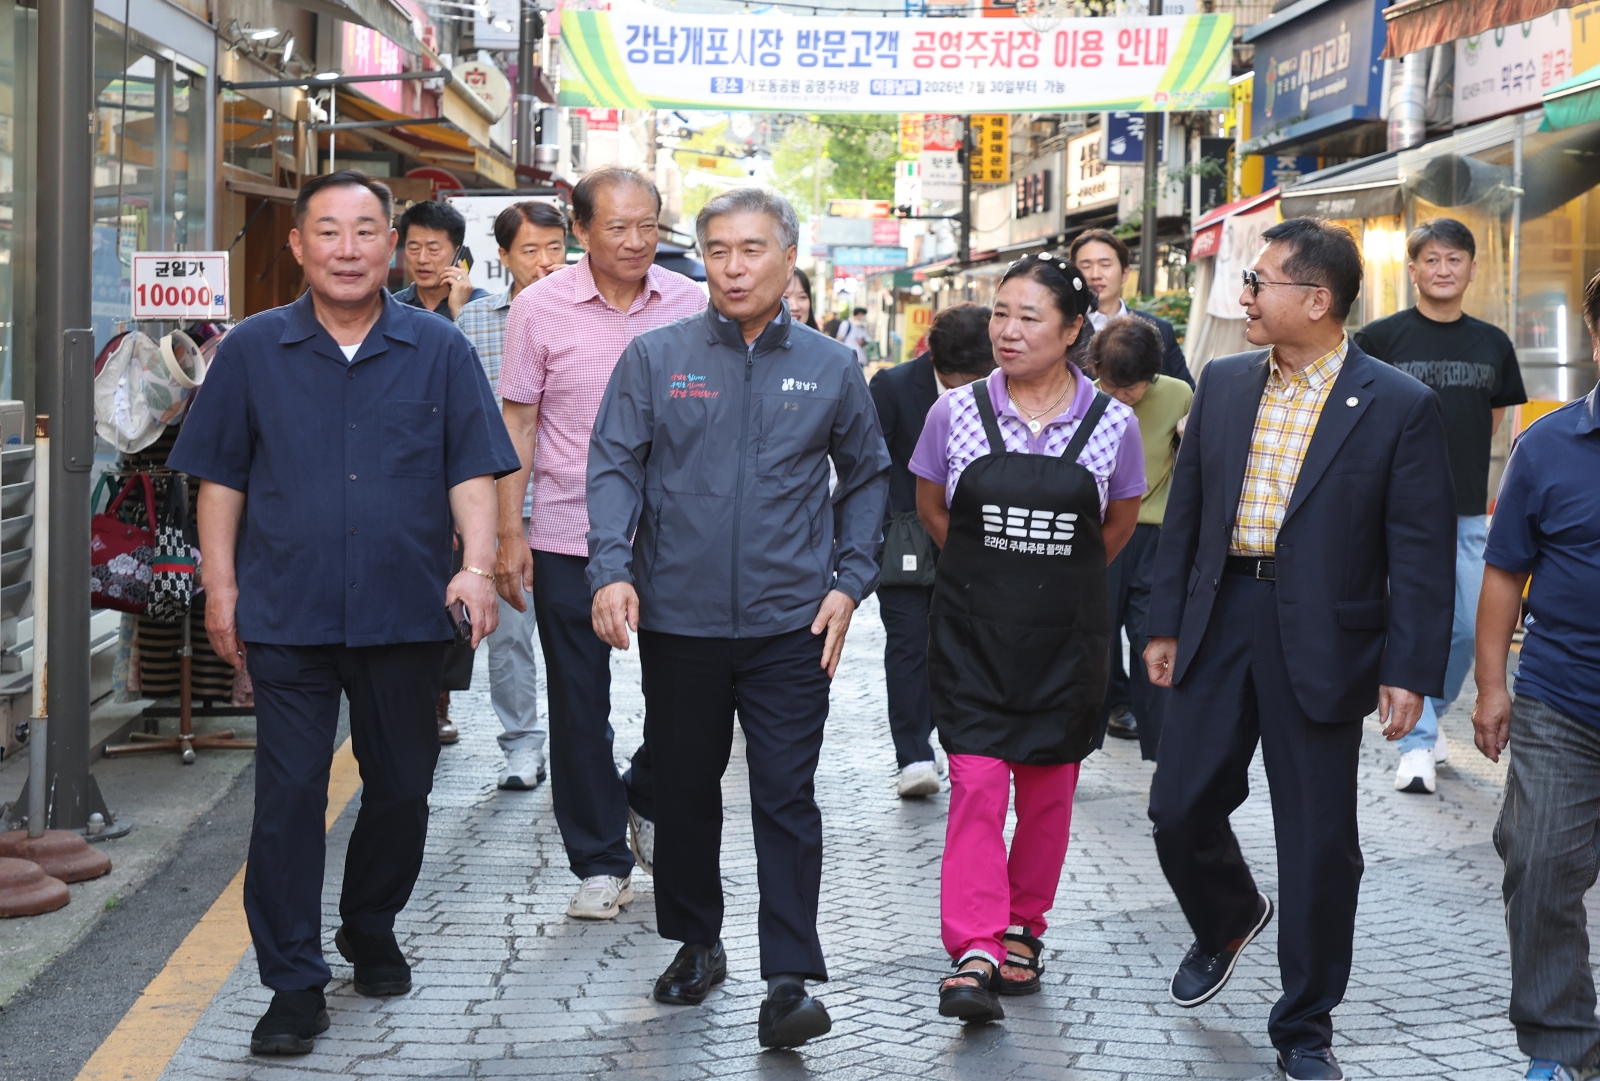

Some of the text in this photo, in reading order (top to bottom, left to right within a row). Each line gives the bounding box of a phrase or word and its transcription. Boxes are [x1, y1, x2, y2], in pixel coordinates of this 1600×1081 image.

[626, 24, 1168, 68] 강남개포시장 방문고객 공영주차장 이용 안내
[1502, 58, 1536, 97] 막국수
[1541, 48, 1572, 88] 칼국
[714, 77, 859, 94] 장소 개포동공원 공영주차장
[924, 81, 964, 94] 2026년
[968, 81, 985, 94] 7월
[990, 80, 1037, 94] 30일부터
[1044, 80, 1065, 94] 가능
[990, 117, 1003, 179] 해물매운탕
[155, 261, 205, 277] 균일가
[795, 380, 818, 391] 강남구
[984, 535, 1072, 556] 온라인 주류주문 플랫폼
